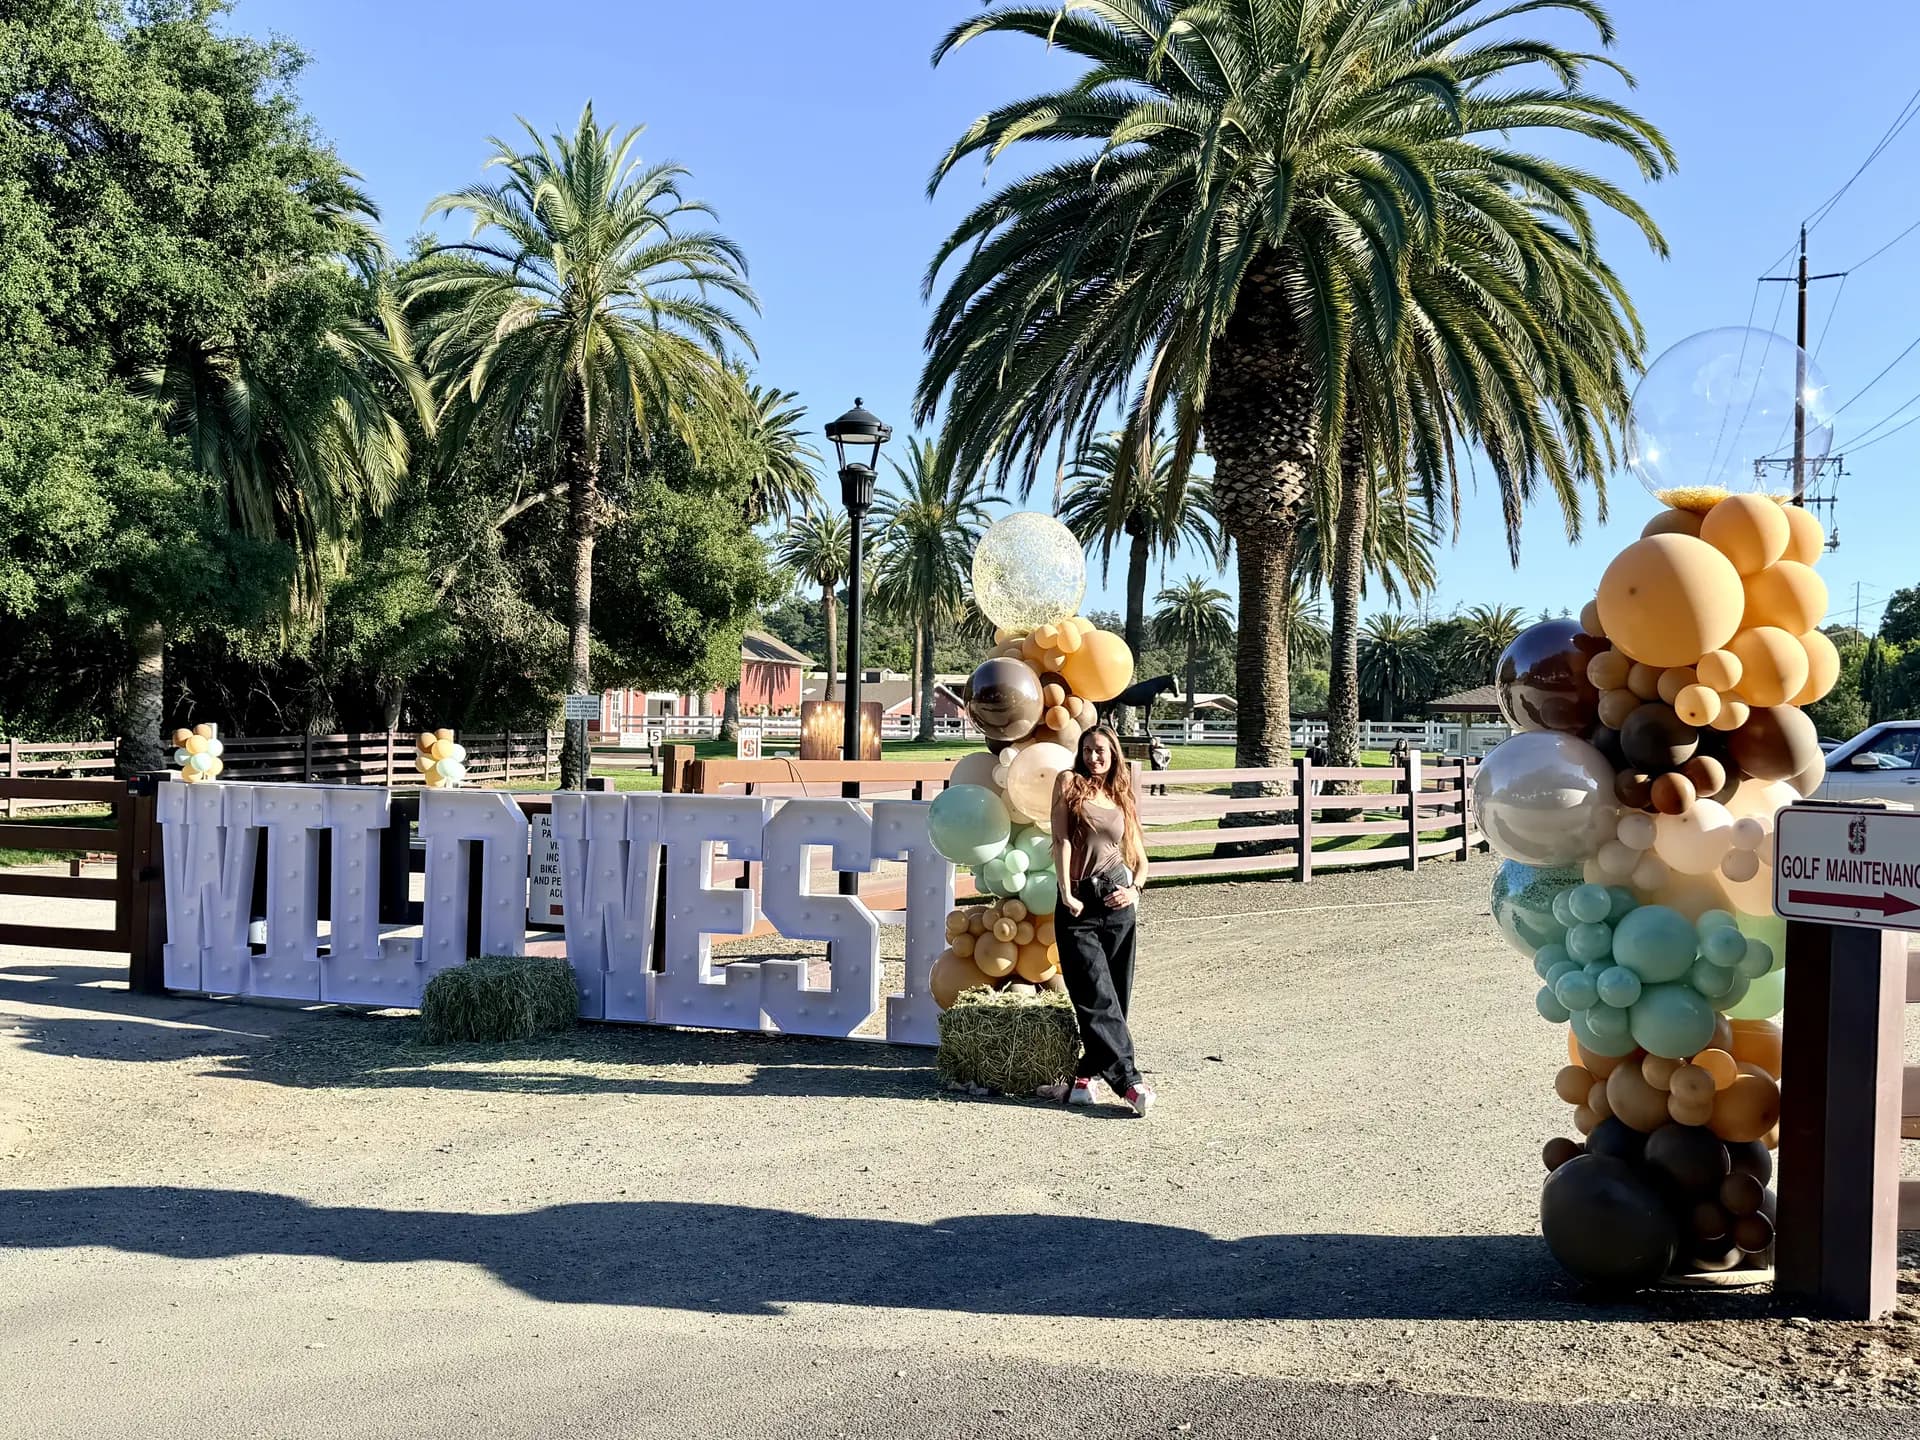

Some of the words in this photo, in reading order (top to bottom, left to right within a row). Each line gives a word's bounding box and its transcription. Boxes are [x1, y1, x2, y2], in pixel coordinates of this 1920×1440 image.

[652, 731, 660, 741] 5
[540, 864, 557, 874] BIKE
[1781, 855, 1820, 880] GOLF
[534, 875, 550, 886] AND
[157, 782, 528, 1008] WILD
[552, 794, 955, 1047] WEST
